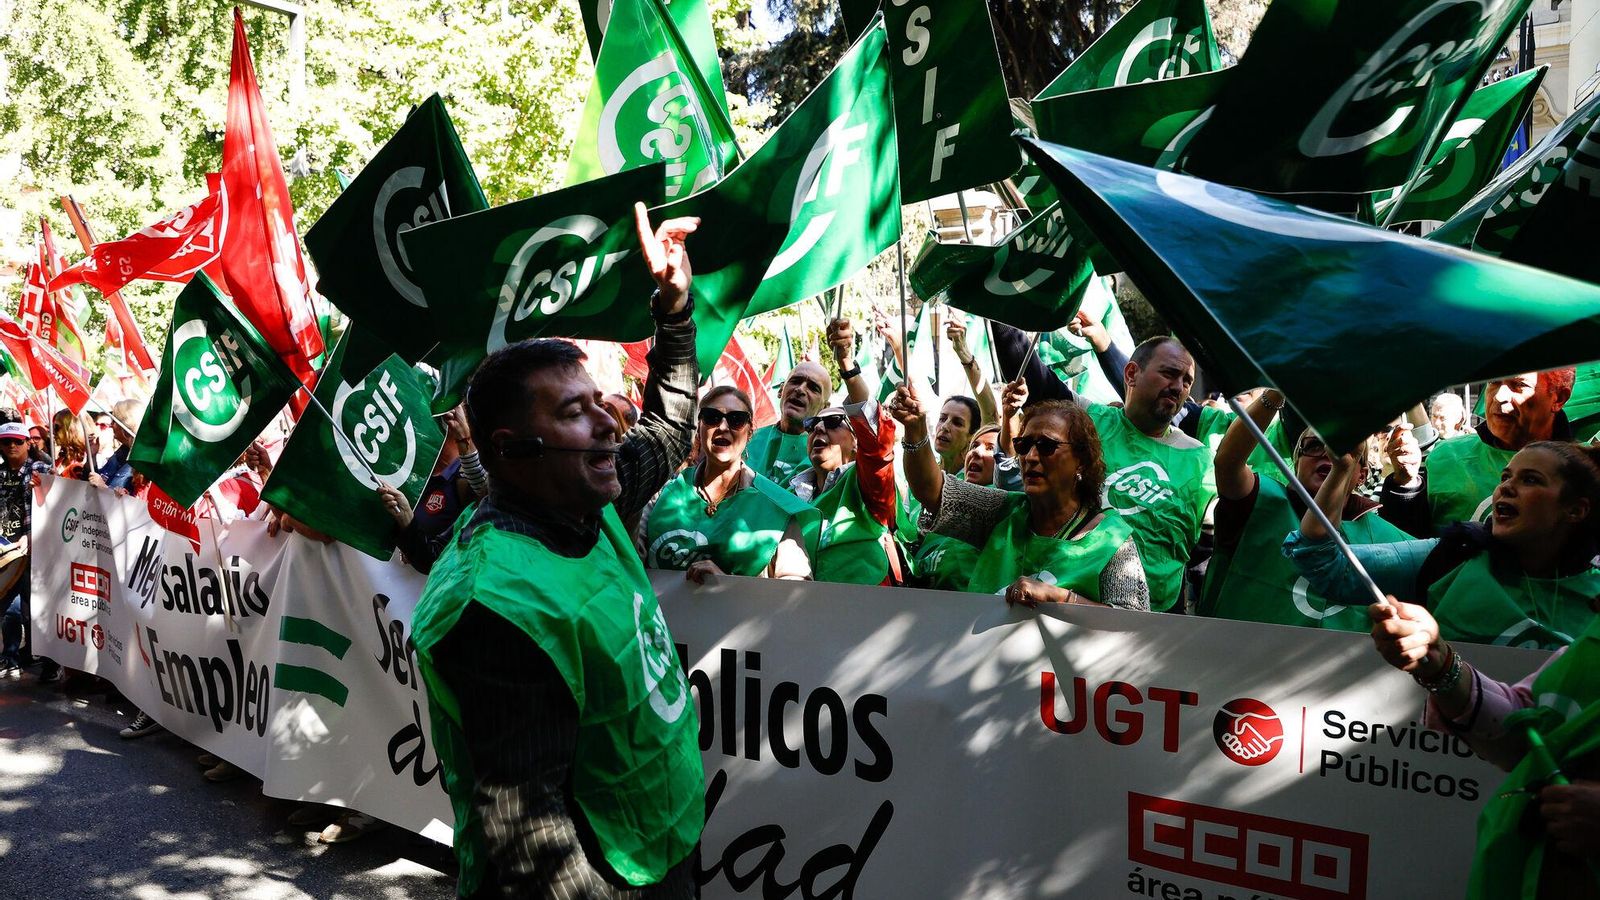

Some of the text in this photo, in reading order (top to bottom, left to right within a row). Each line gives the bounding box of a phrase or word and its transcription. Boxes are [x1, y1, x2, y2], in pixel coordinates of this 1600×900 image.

[891, 0, 960, 183] SIF
[353, 369, 404, 464] CSIF
[71, 592, 89, 607] área
[161, 552, 270, 617] salario
[56, 613, 88, 646] UGT
[146, 626, 269, 738] Empleo
[1040, 671, 1199, 753] UGT
[1322, 710, 1480, 760] Servicio
[1319, 749, 1480, 801] Públicos
[1143, 809, 1352, 895] CCOO
